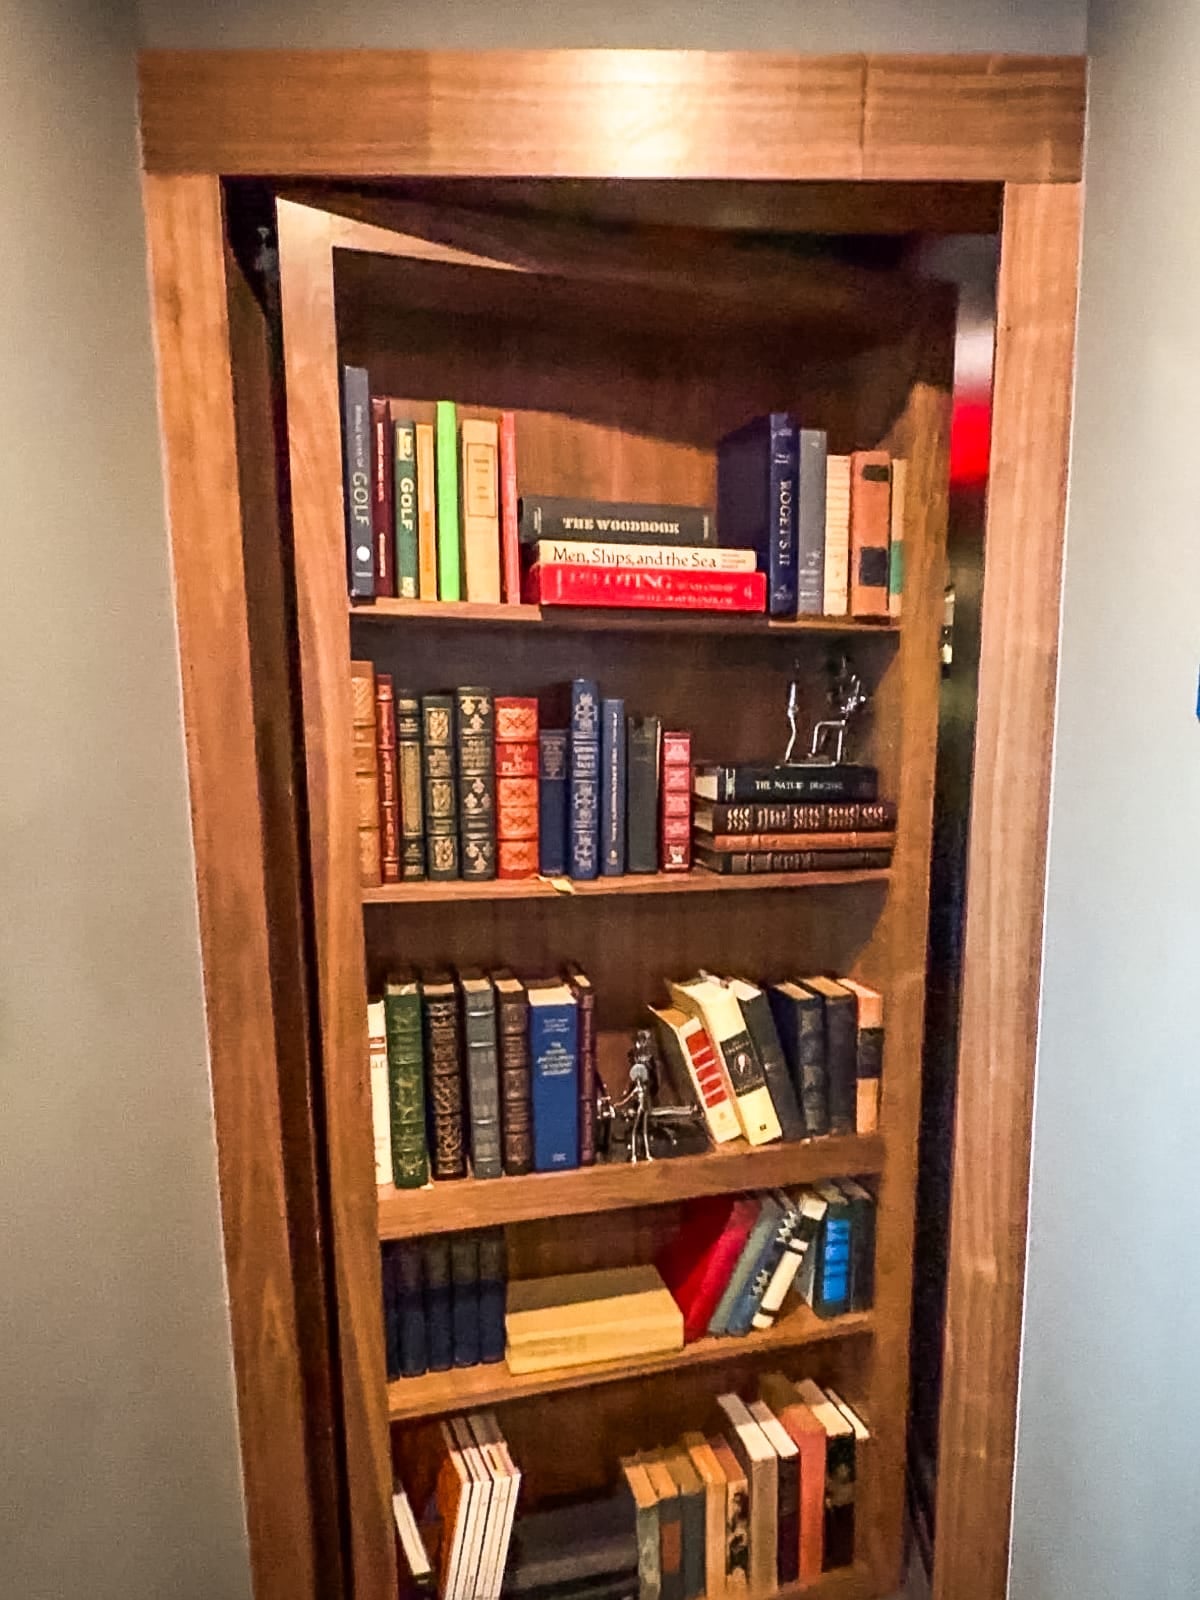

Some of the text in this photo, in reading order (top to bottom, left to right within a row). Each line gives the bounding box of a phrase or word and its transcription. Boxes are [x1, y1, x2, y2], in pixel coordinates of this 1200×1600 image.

[352, 472, 370, 526] GOLF
[400, 477, 415, 532] GOLF
[563, 517, 680, 534] THE WOODBOOK
[553, 546, 590, 563] Men,
[592, 547, 635, 567] Ships,
[636, 550, 664, 566] and
[665, 551, 689, 567] the
[692, 552, 717, 569] Sea
